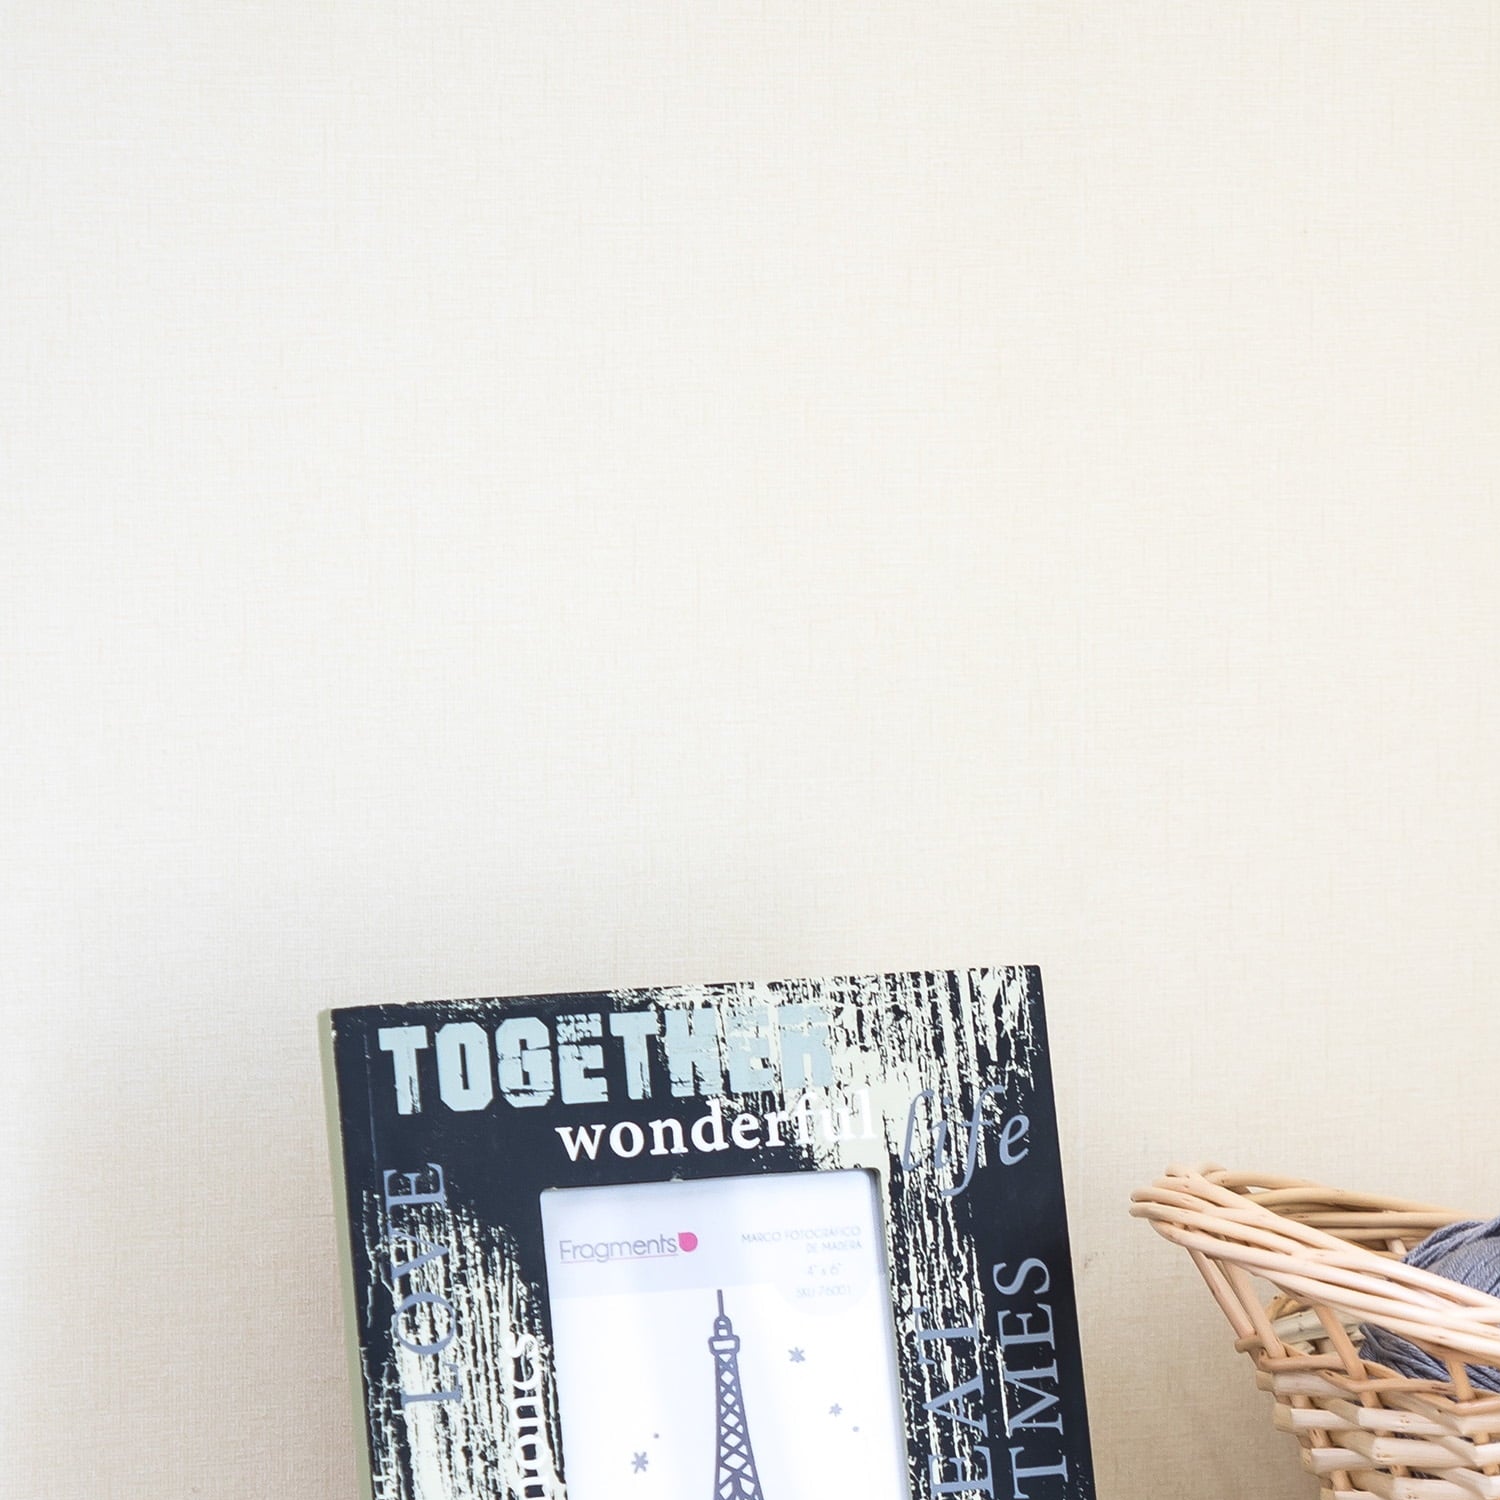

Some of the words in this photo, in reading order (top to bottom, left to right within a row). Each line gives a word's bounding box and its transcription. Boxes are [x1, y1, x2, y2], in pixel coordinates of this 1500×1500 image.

[378, 1003, 834, 1115] TOGETHER
[555, 1087, 877, 1162] wonderful
[902, 1084, 1030, 1197] life
[383, 1163, 462, 1408] LOVE
[559, 1234, 677, 1263] Fragments
